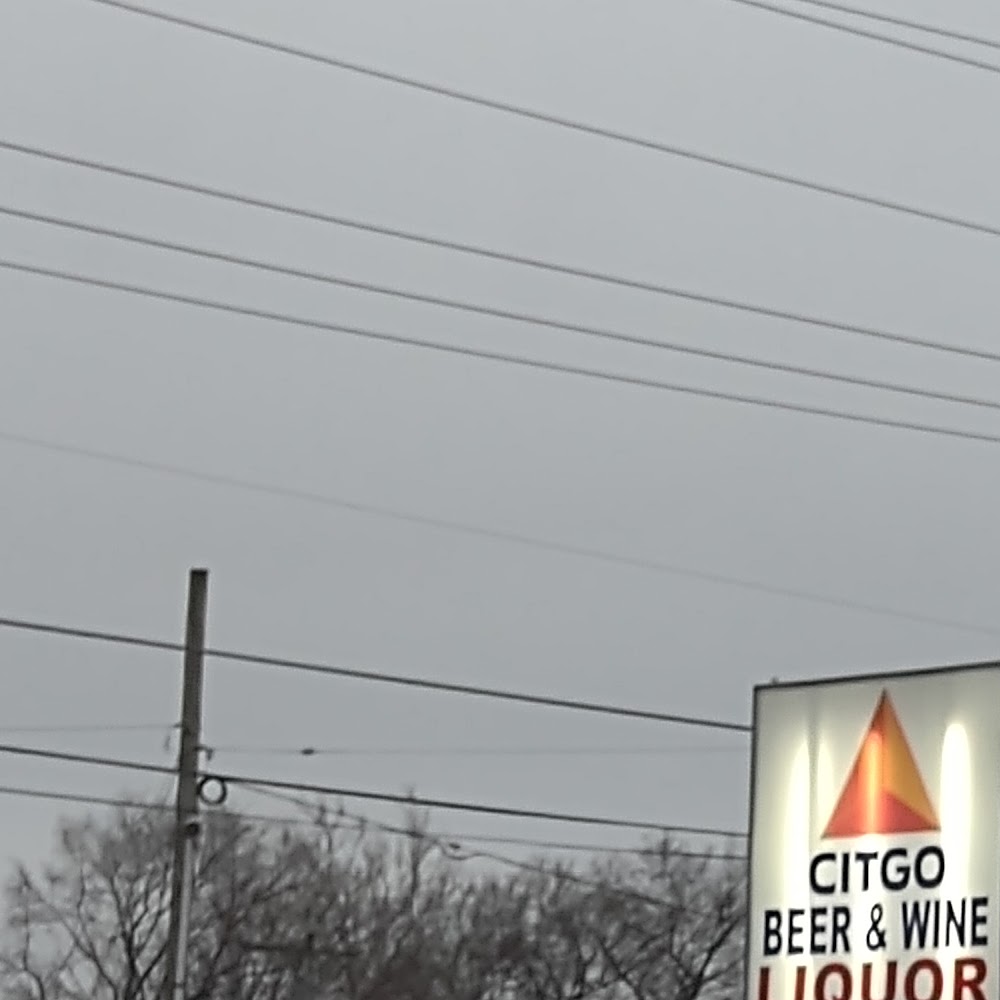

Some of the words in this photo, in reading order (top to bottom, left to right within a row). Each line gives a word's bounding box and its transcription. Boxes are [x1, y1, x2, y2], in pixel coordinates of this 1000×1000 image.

[809, 846, 945, 894] CITGO
[763, 905, 851, 956] BEER
[866, 903, 887, 951] &
[902, 897, 989, 950] WINE
